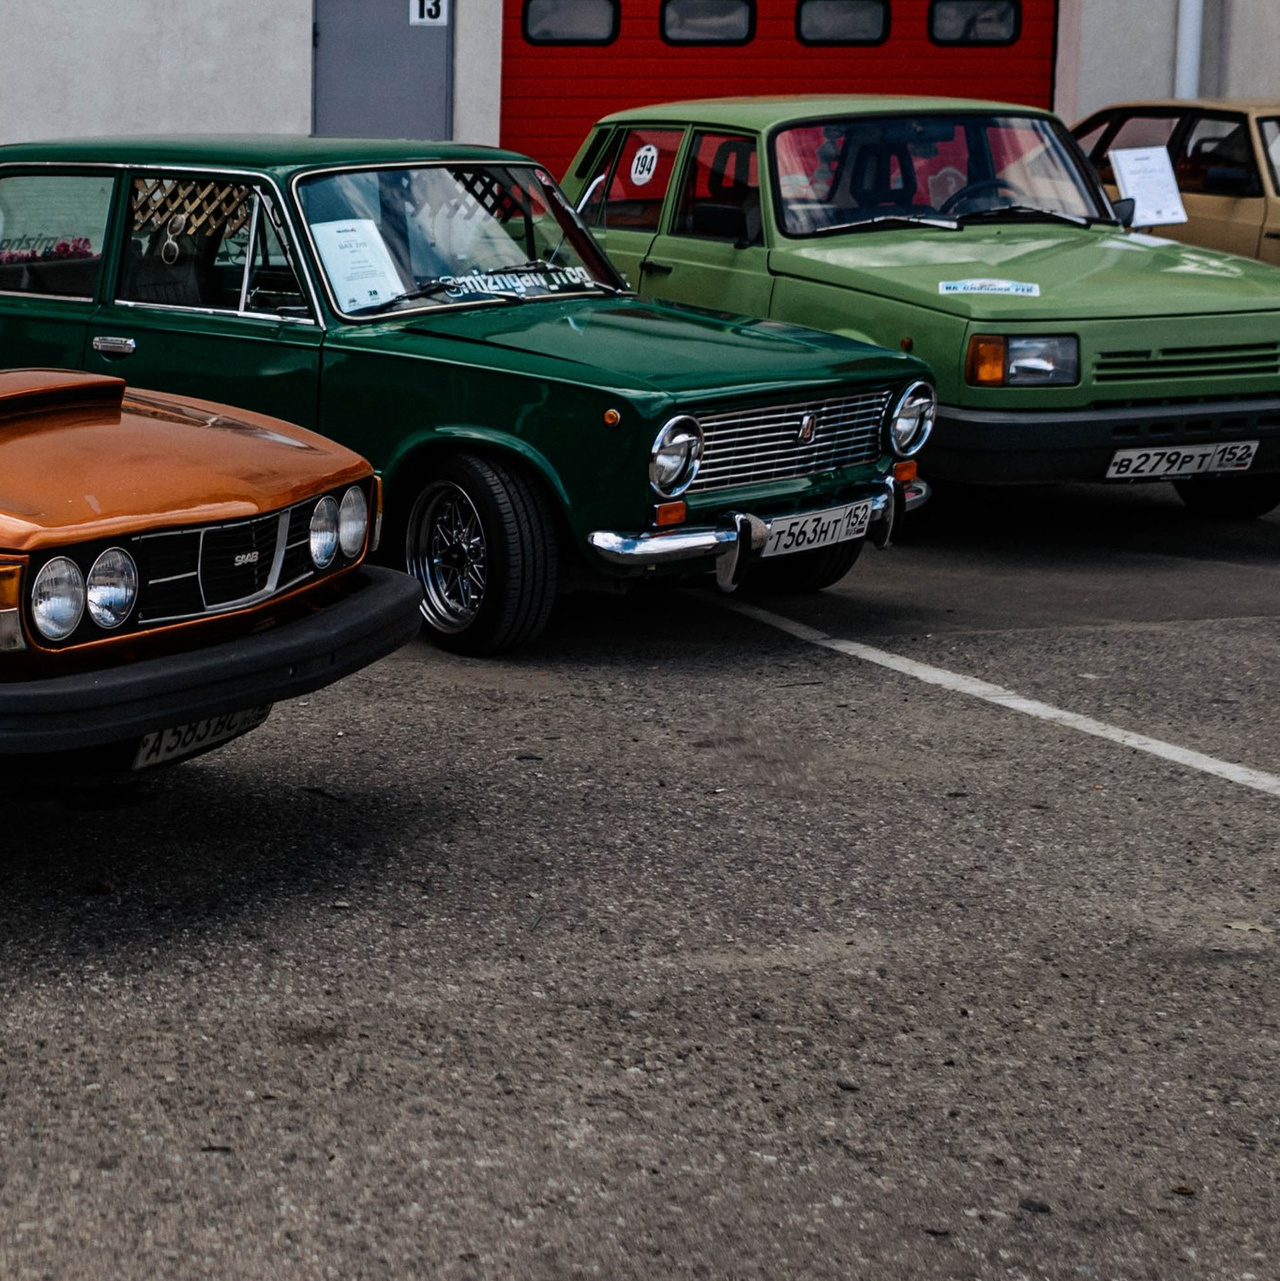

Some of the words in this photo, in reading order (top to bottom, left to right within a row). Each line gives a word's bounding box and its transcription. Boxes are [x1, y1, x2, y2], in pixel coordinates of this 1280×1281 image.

[634, 155, 654, 175] 194
[1216, 444, 1250, 463] 152
[845, 504, 869, 529] 152
[233, 551, 259, 567] SAAB
